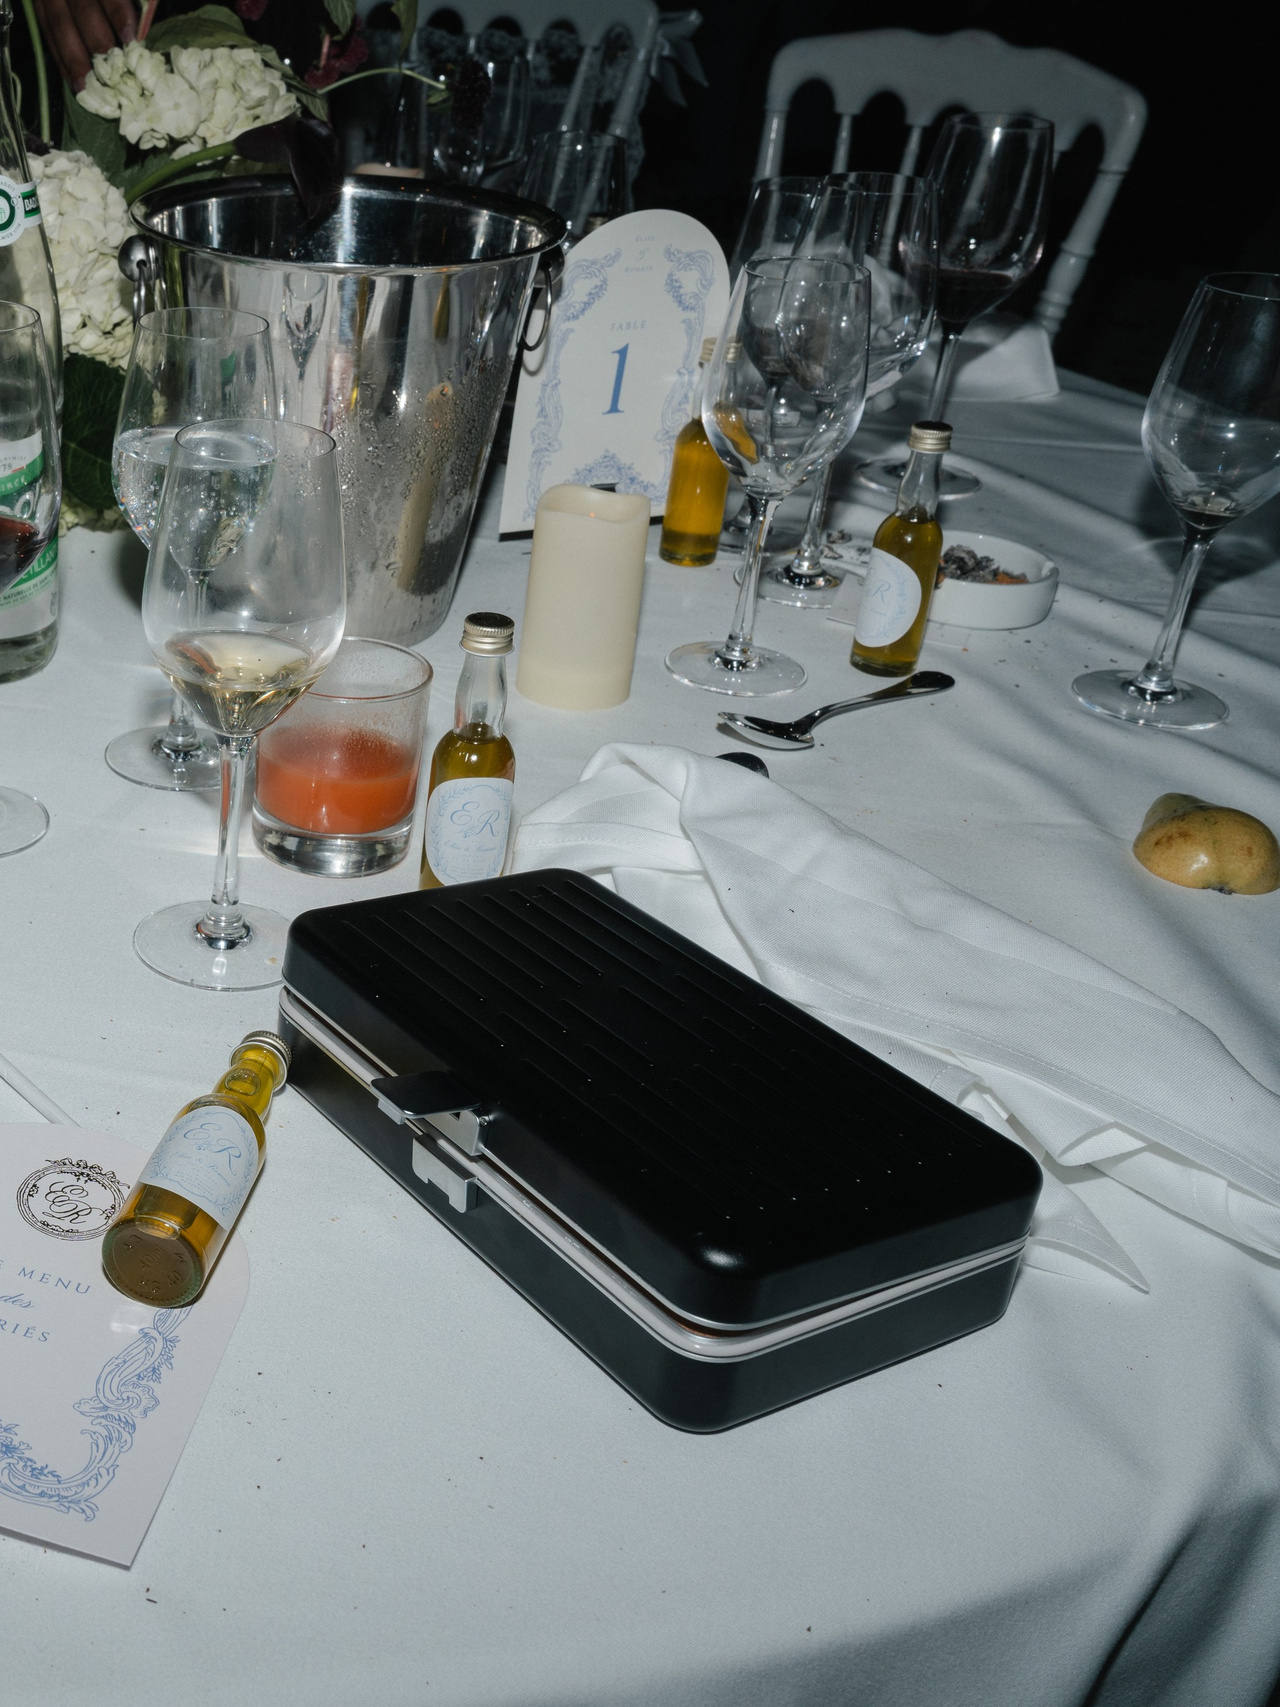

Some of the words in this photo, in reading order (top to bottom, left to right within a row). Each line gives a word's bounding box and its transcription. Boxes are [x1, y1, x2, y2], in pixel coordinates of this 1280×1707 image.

[610, 320, 647, 332] TABLE
[601, 342, 629, 415] 1
[17, 1266, 92, 1295] MENU
